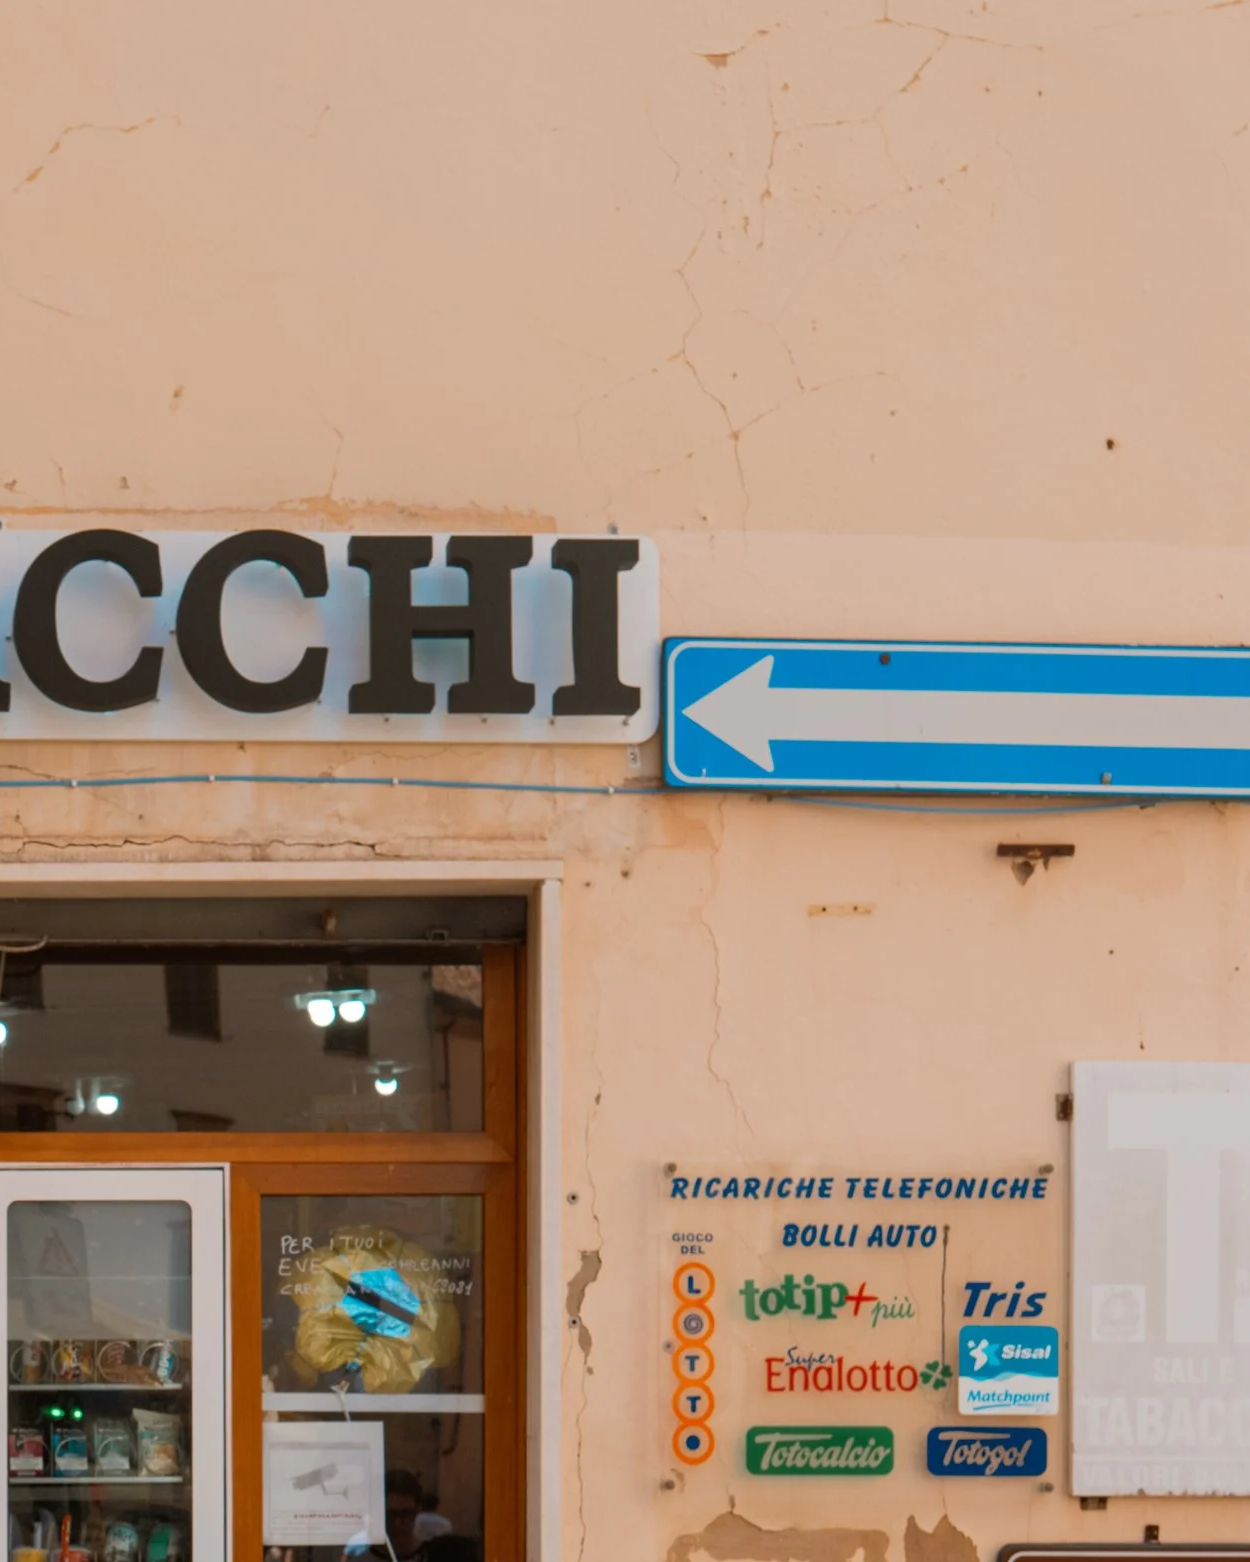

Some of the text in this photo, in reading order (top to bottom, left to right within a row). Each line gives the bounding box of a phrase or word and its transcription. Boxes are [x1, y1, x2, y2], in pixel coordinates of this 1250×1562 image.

[670, 1177, 1049, 1200] RICARICHE TELEFONICHE
[281, 1235, 315, 1255] PER
[672, 1232, 714, 1243] GIOCO
[782, 1223, 937, 1248] BOLLI AUTO
[680, 1245, 705, 1255] DEL
[963, 1281, 1047, 1318] Tris
[871, 1297, 915, 1328] più
[785, 1346, 836, 1368] Super
[1001, 1344, 1052, 1360] Sisal
[765, 1357, 919, 1393] Enalotto
[1152, 1356, 1236, 1384] SALI E
[967, 1390, 1050, 1406] Matchpoint
[754, 1433, 890, 1470] Totocalcio
[938, 1432, 1031, 1475] Totogol
